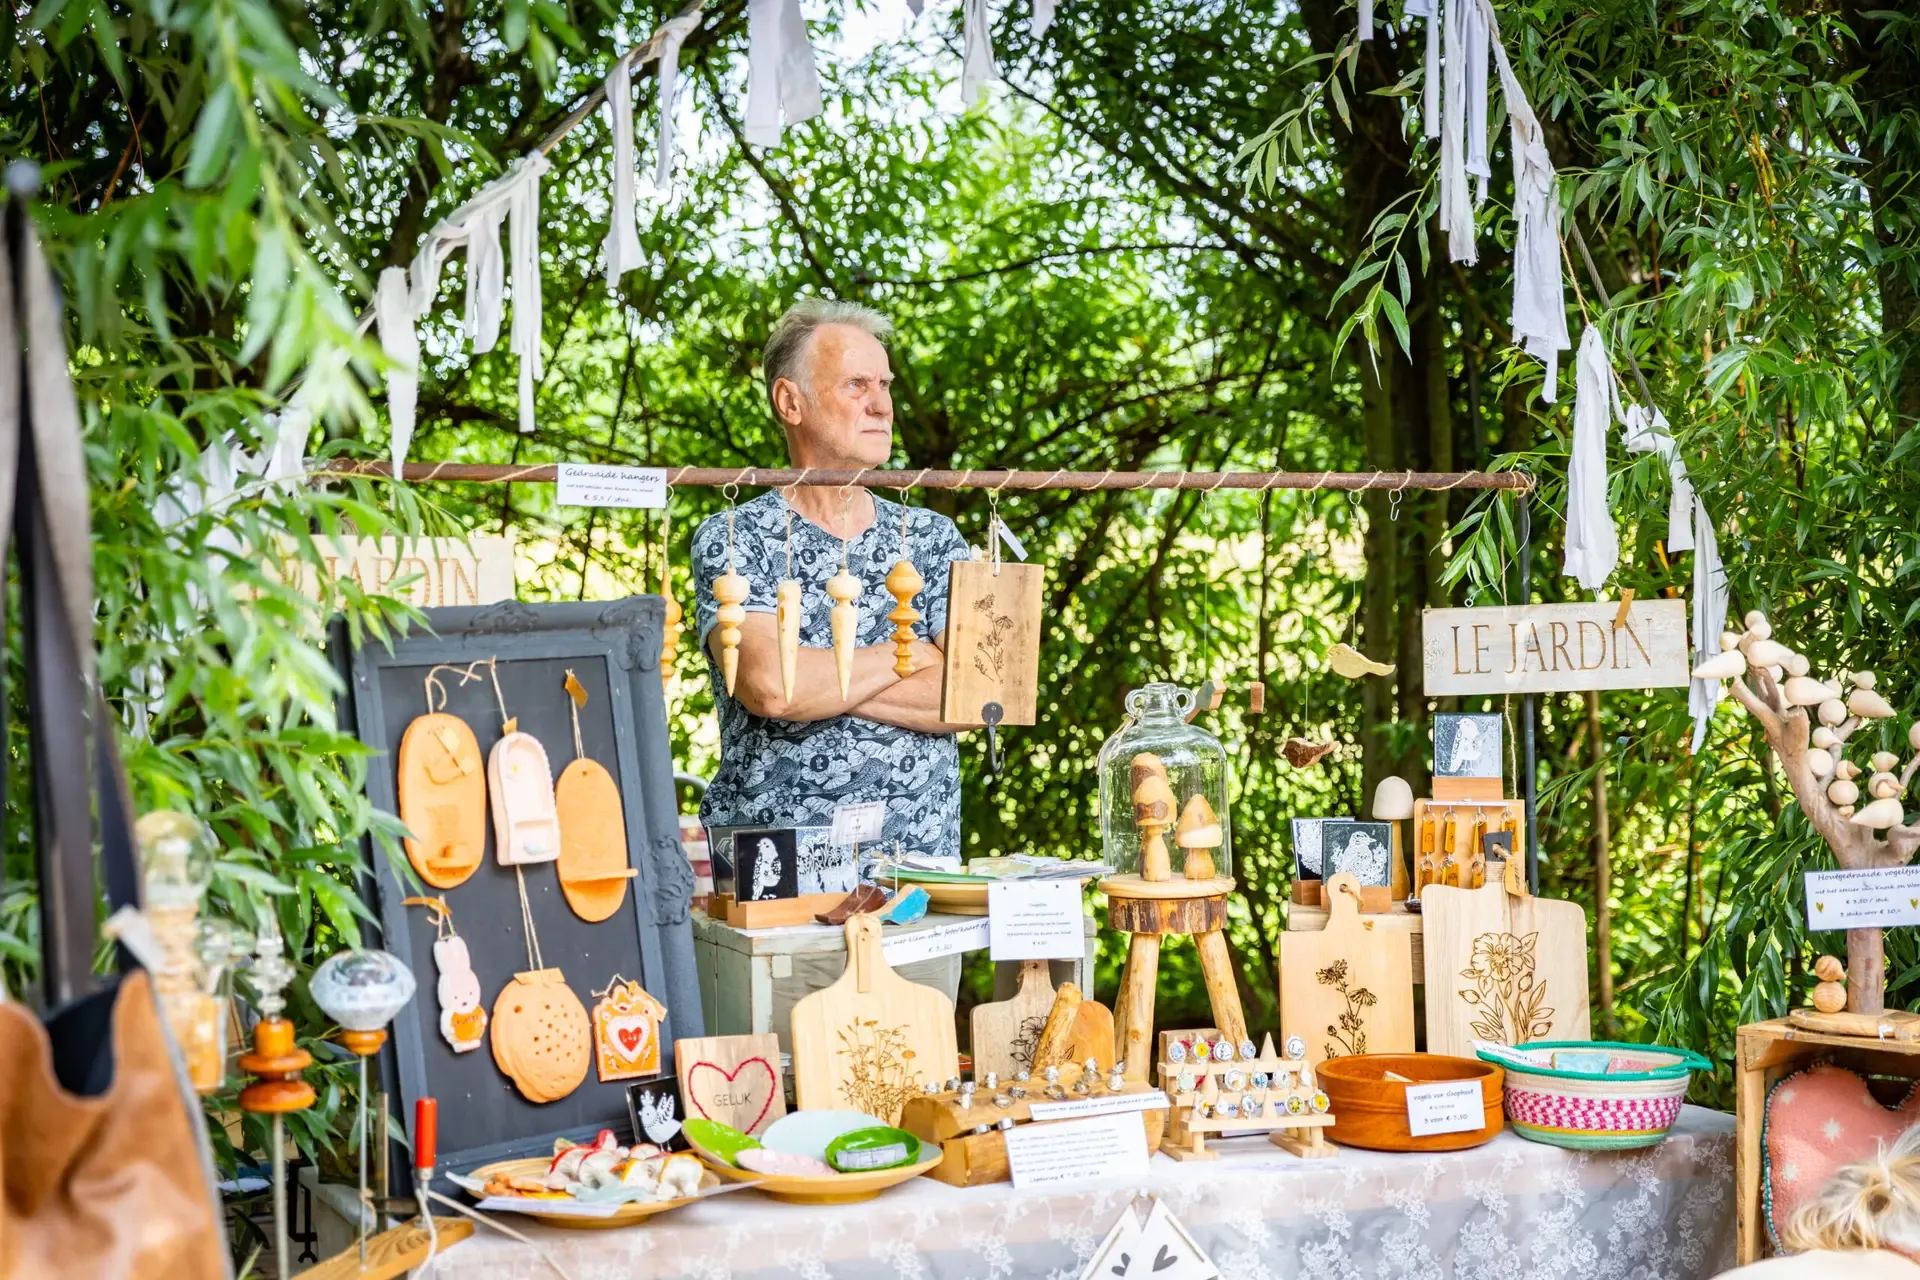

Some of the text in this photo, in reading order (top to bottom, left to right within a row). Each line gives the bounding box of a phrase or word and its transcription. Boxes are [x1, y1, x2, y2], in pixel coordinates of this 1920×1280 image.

[565, 467, 661, 484] Gedraaide hangers
[1450, 618, 1654, 675] LE JARDIN
[1817, 871, 1882, 882] Houtgedraaide
[980, 921, 989, 930] of
[713, 1092, 752, 1107] GELUK
[1413, 1093, 1432, 1102] vogels
